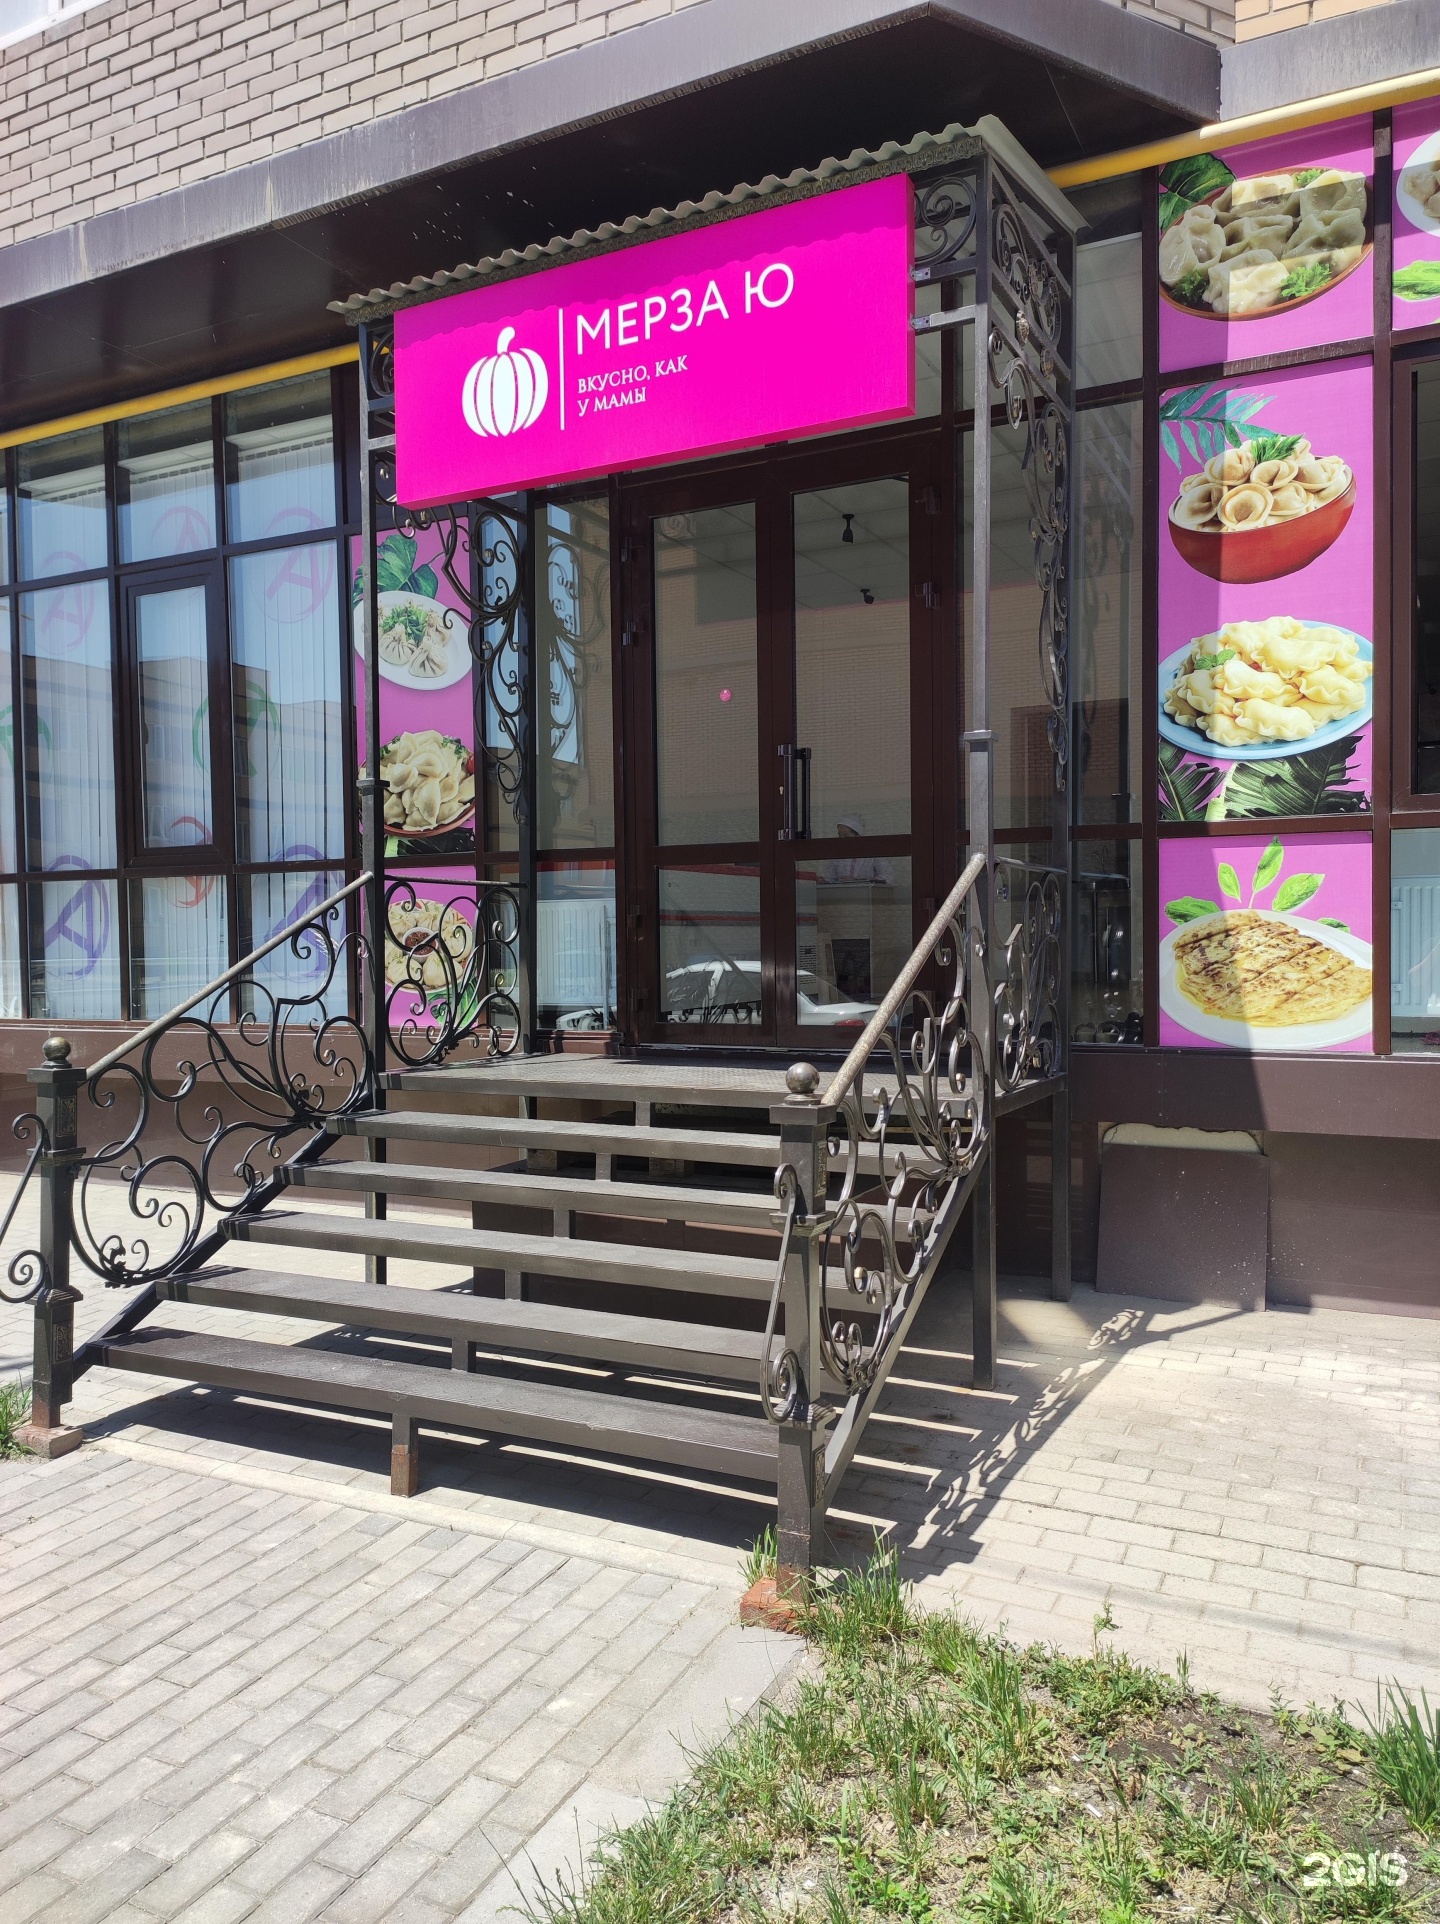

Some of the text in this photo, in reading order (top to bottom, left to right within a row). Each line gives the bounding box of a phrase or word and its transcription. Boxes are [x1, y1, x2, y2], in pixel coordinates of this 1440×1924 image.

[576, 262, 794, 355] МЕРЗА Ю
[578, 355, 688, 394] ВКУСНО, КАК
[577, 386, 647, 417] У МАМЫ
